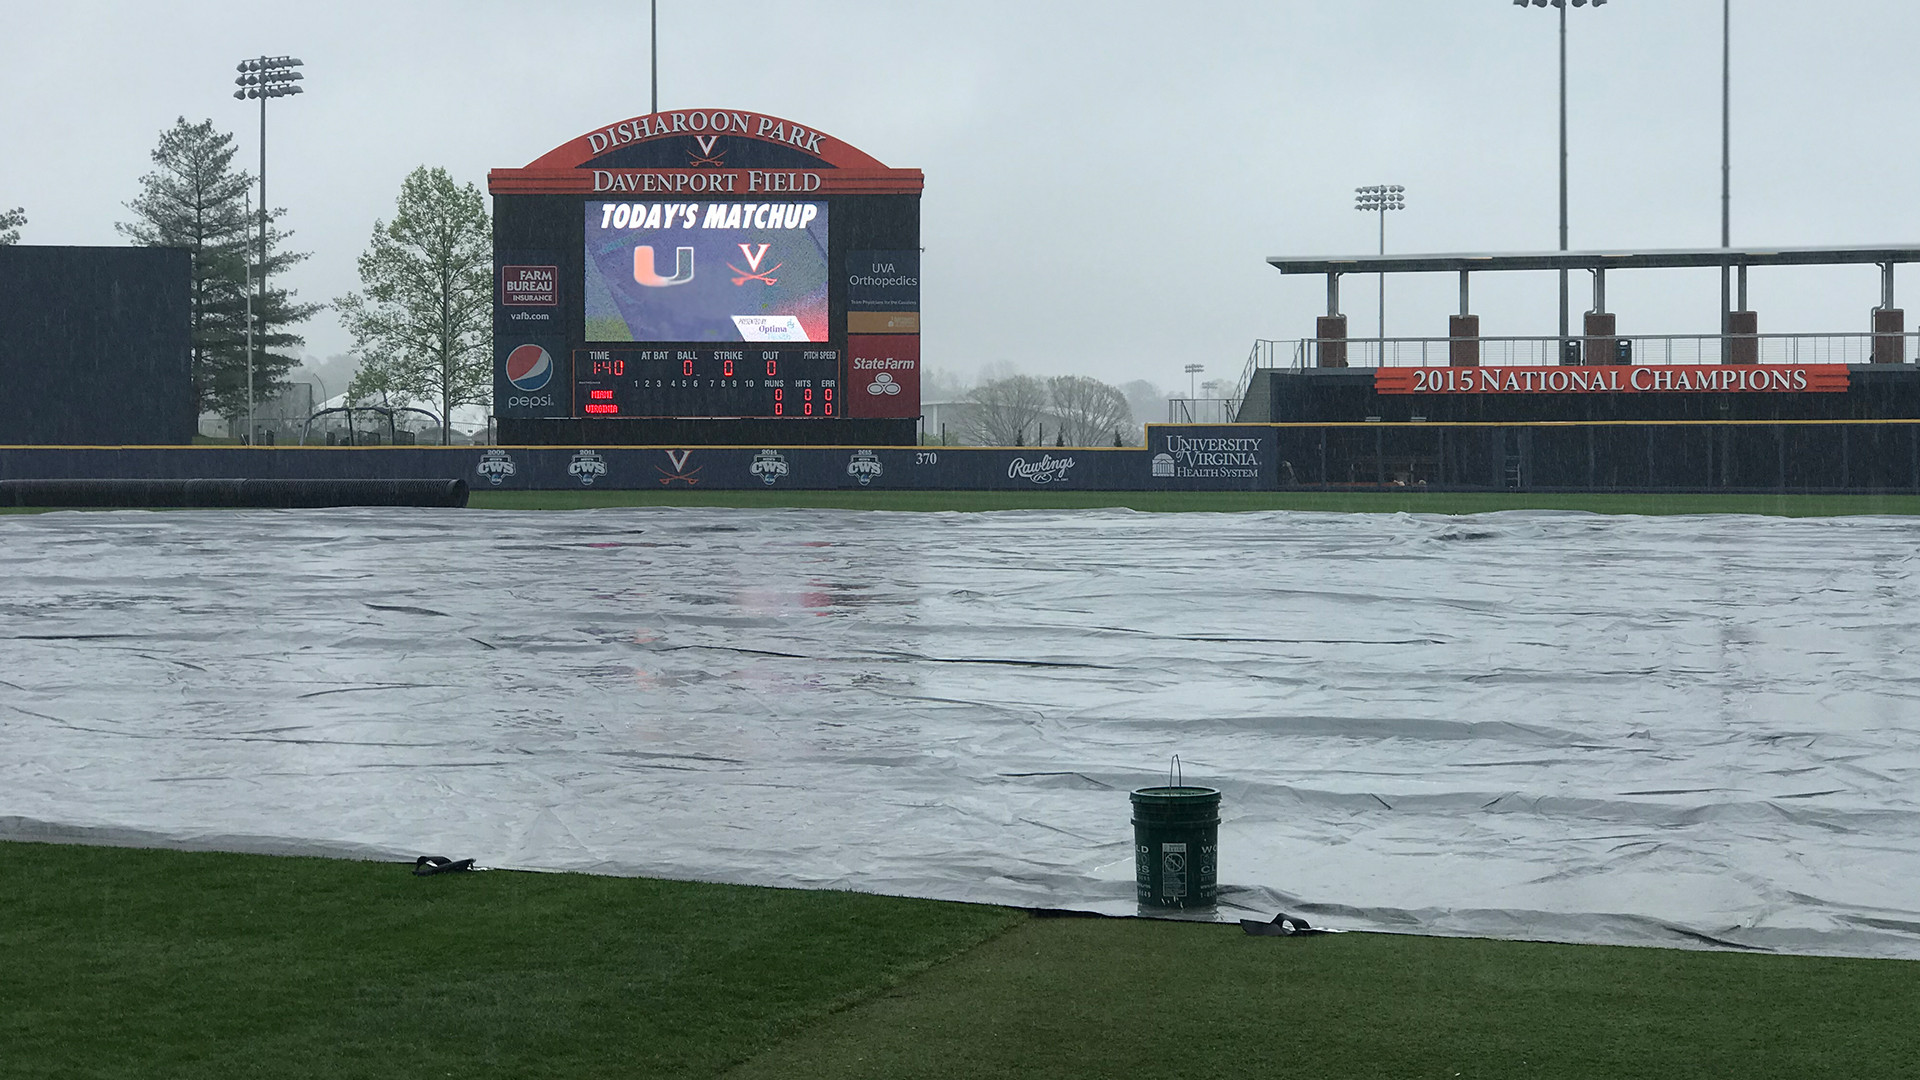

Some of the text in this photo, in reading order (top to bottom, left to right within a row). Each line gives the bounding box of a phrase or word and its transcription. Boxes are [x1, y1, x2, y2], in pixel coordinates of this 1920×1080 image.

[587, 111, 826, 155] DISHAROON PARK
[592, 170, 821, 192] DAVENPORT FIELD
[601, 203, 818, 229] TODAY'S MATCHUP
[872, 263, 895, 273] UVA
[520, 270, 552, 280] FARM
[849, 275, 918, 288] Orthopedics
[506, 281, 553, 291] BUREAU
[511, 312, 550, 320] vafb.com
[758, 326, 788, 334] Optima
[590, 351, 837, 360] TIME AT BAT BALL STRIKE OUT PITCH SPEED
[593, 360, 777, 376] 1:40 0 0 0
[1413, 367, 1807, 391] 2015 NATIONAL CHAMPIONS
[508, 394, 551, 408] pepsi
[775, 389, 782, 401] 0
[805, 389, 812, 401] 0
[825, 389, 832, 401] 0
[585, 403, 832, 415] VIRGINIA 0 0 0
[1166, 435, 1262, 452] UNIVERSITY
[916, 452, 937, 465] 370
[1186, 451, 1258, 467] VIRGINIA
[478, 461, 514, 474] CWS
[569, 461, 605, 474] CWS
[751, 461, 787, 474] CWS
[848, 461, 880, 474] CWS
[1008, 454, 1075, 478] Rawlings
[1177, 467, 1258, 477] HEALTH SYSTEM
